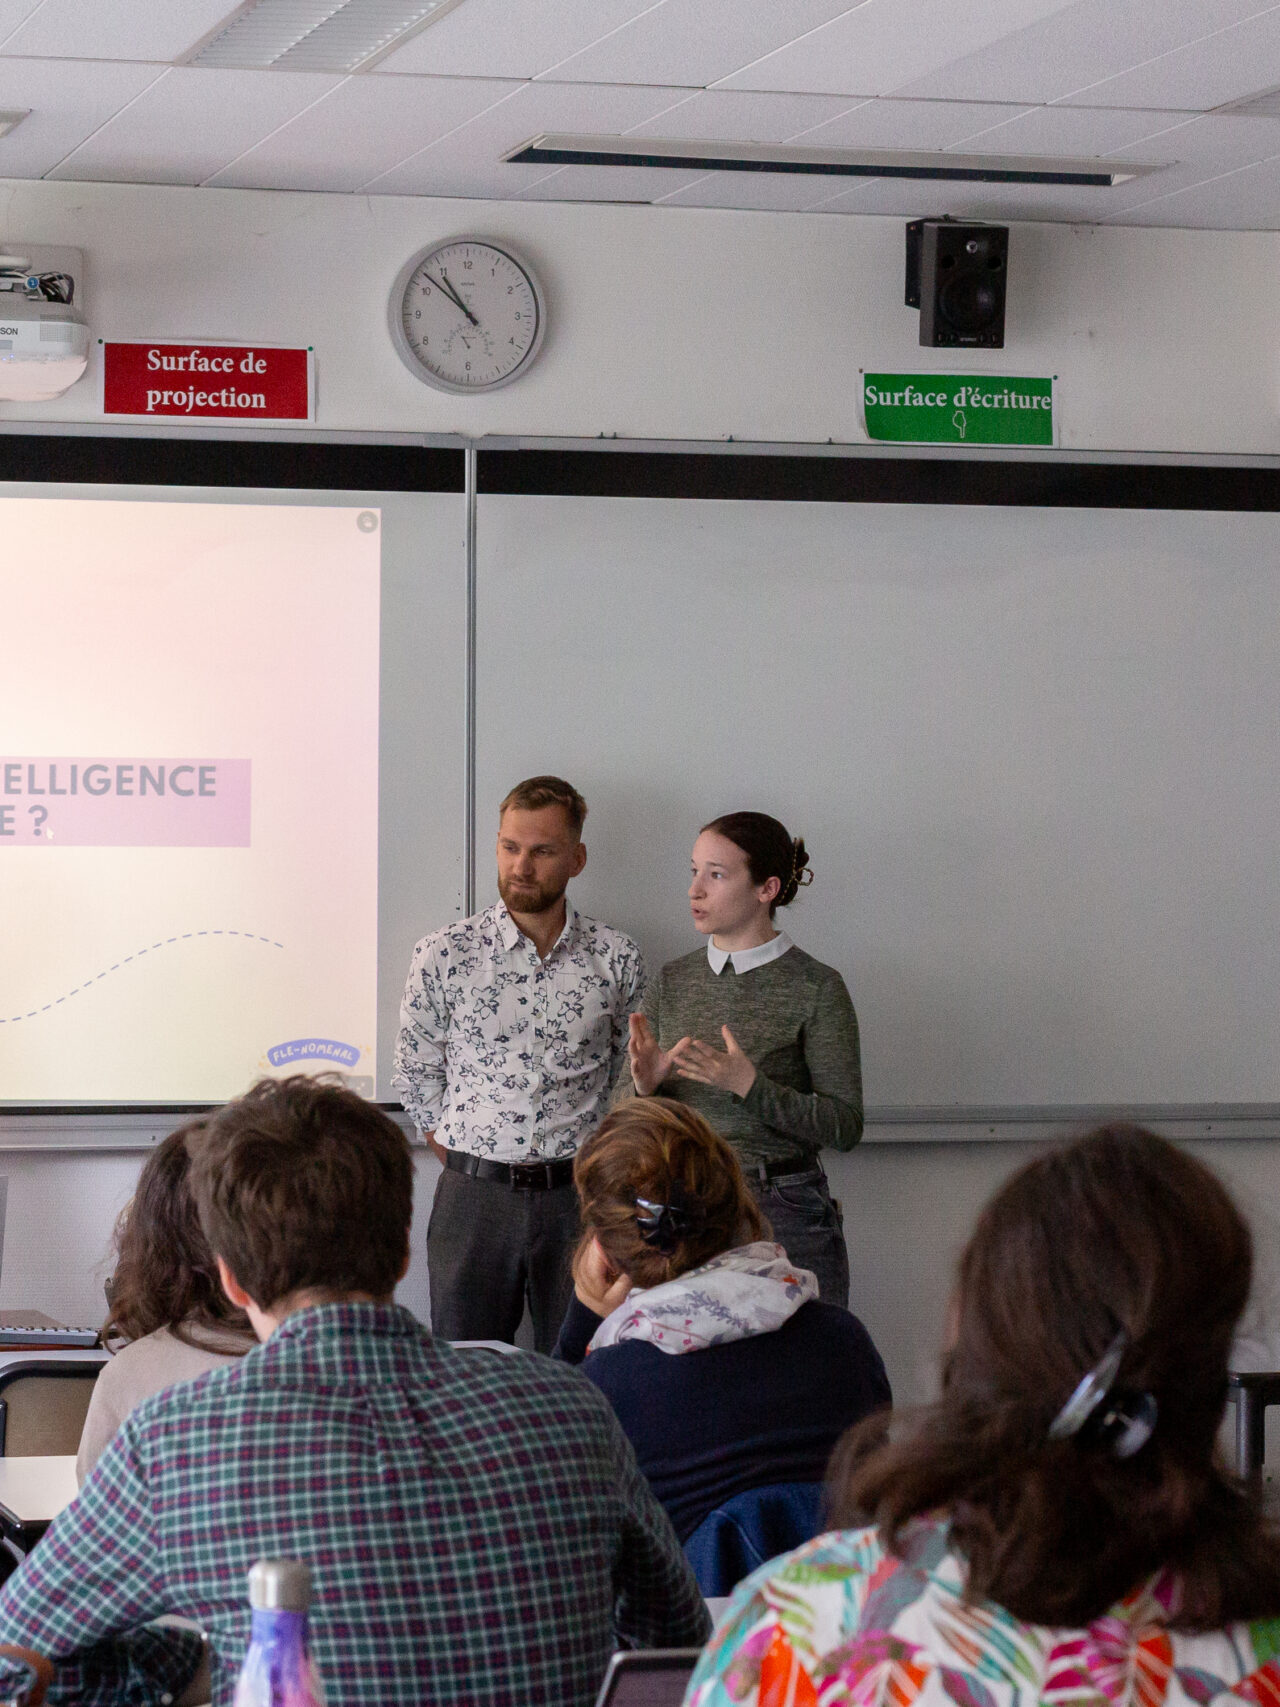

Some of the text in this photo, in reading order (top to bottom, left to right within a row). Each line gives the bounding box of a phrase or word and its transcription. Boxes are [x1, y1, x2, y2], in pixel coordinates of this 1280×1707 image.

[463, 261, 473, 270] 12
[440, 267, 448, 276] 11
[491, 268, 495, 277] 1
[422, 287, 431, 296] 10
[507, 286, 514, 295] 2
[415, 310, 422, 319] 9
[514, 311, 521, 321] 3
[422, 336, 429, 345] 8
[508, 337, 515, 345] 4
[147, 349, 268, 374] Surface de
[465, 361, 471, 371] 6
[145, 385, 267, 413] projection
[865, 385, 1052, 410] Surface d'écriture
